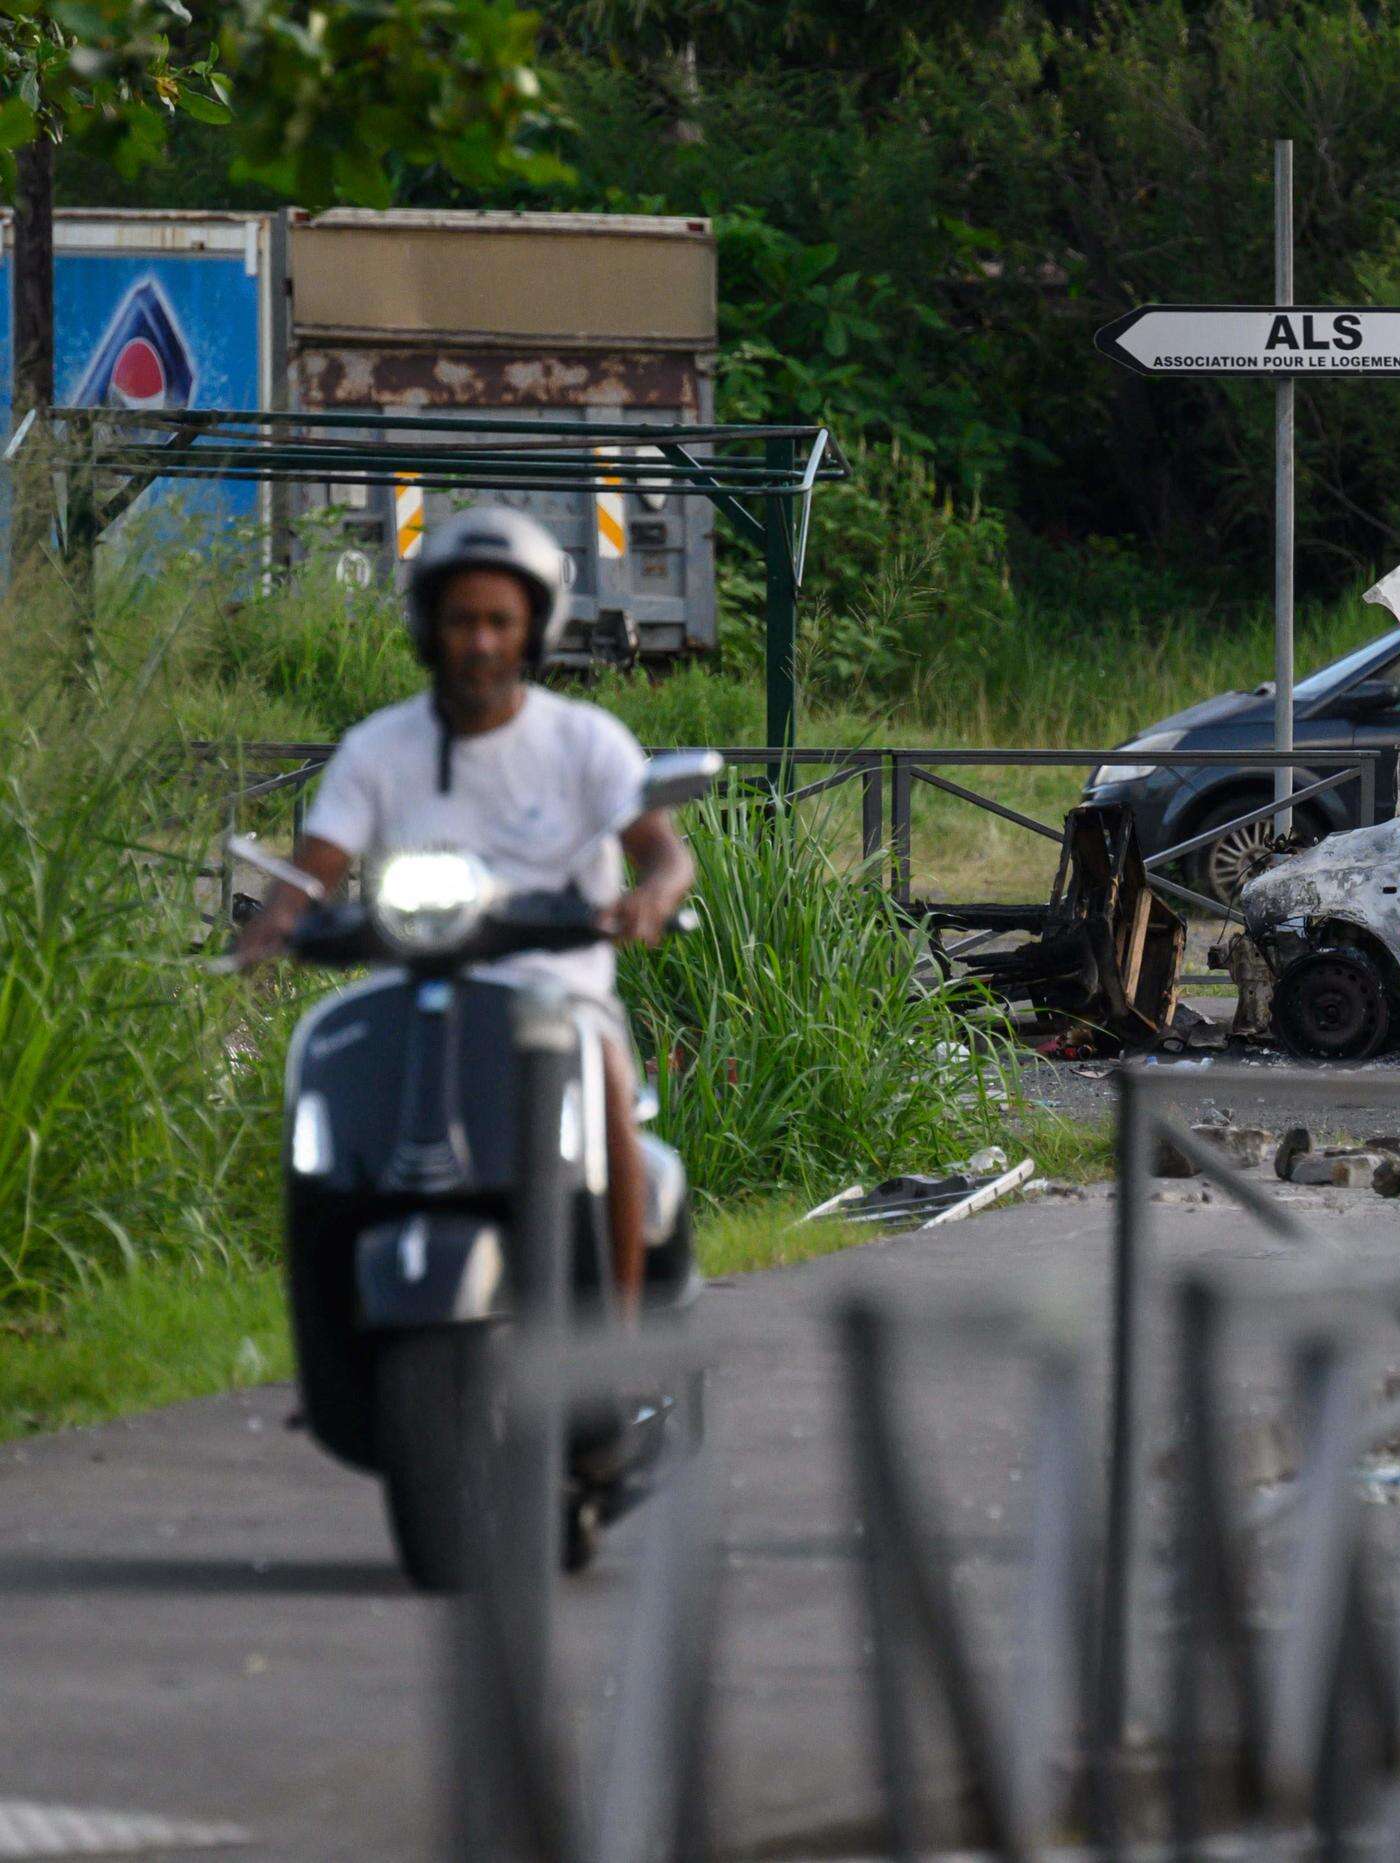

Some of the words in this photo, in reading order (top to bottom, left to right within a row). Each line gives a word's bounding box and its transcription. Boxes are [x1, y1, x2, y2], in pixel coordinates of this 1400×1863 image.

[1264, 314, 1363, 351] ALS
[1153, 356, 1258, 367] ASSOCIATION
[1263, 356, 1304, 367] POUR
[1309, 356, 1327, 367] LE
